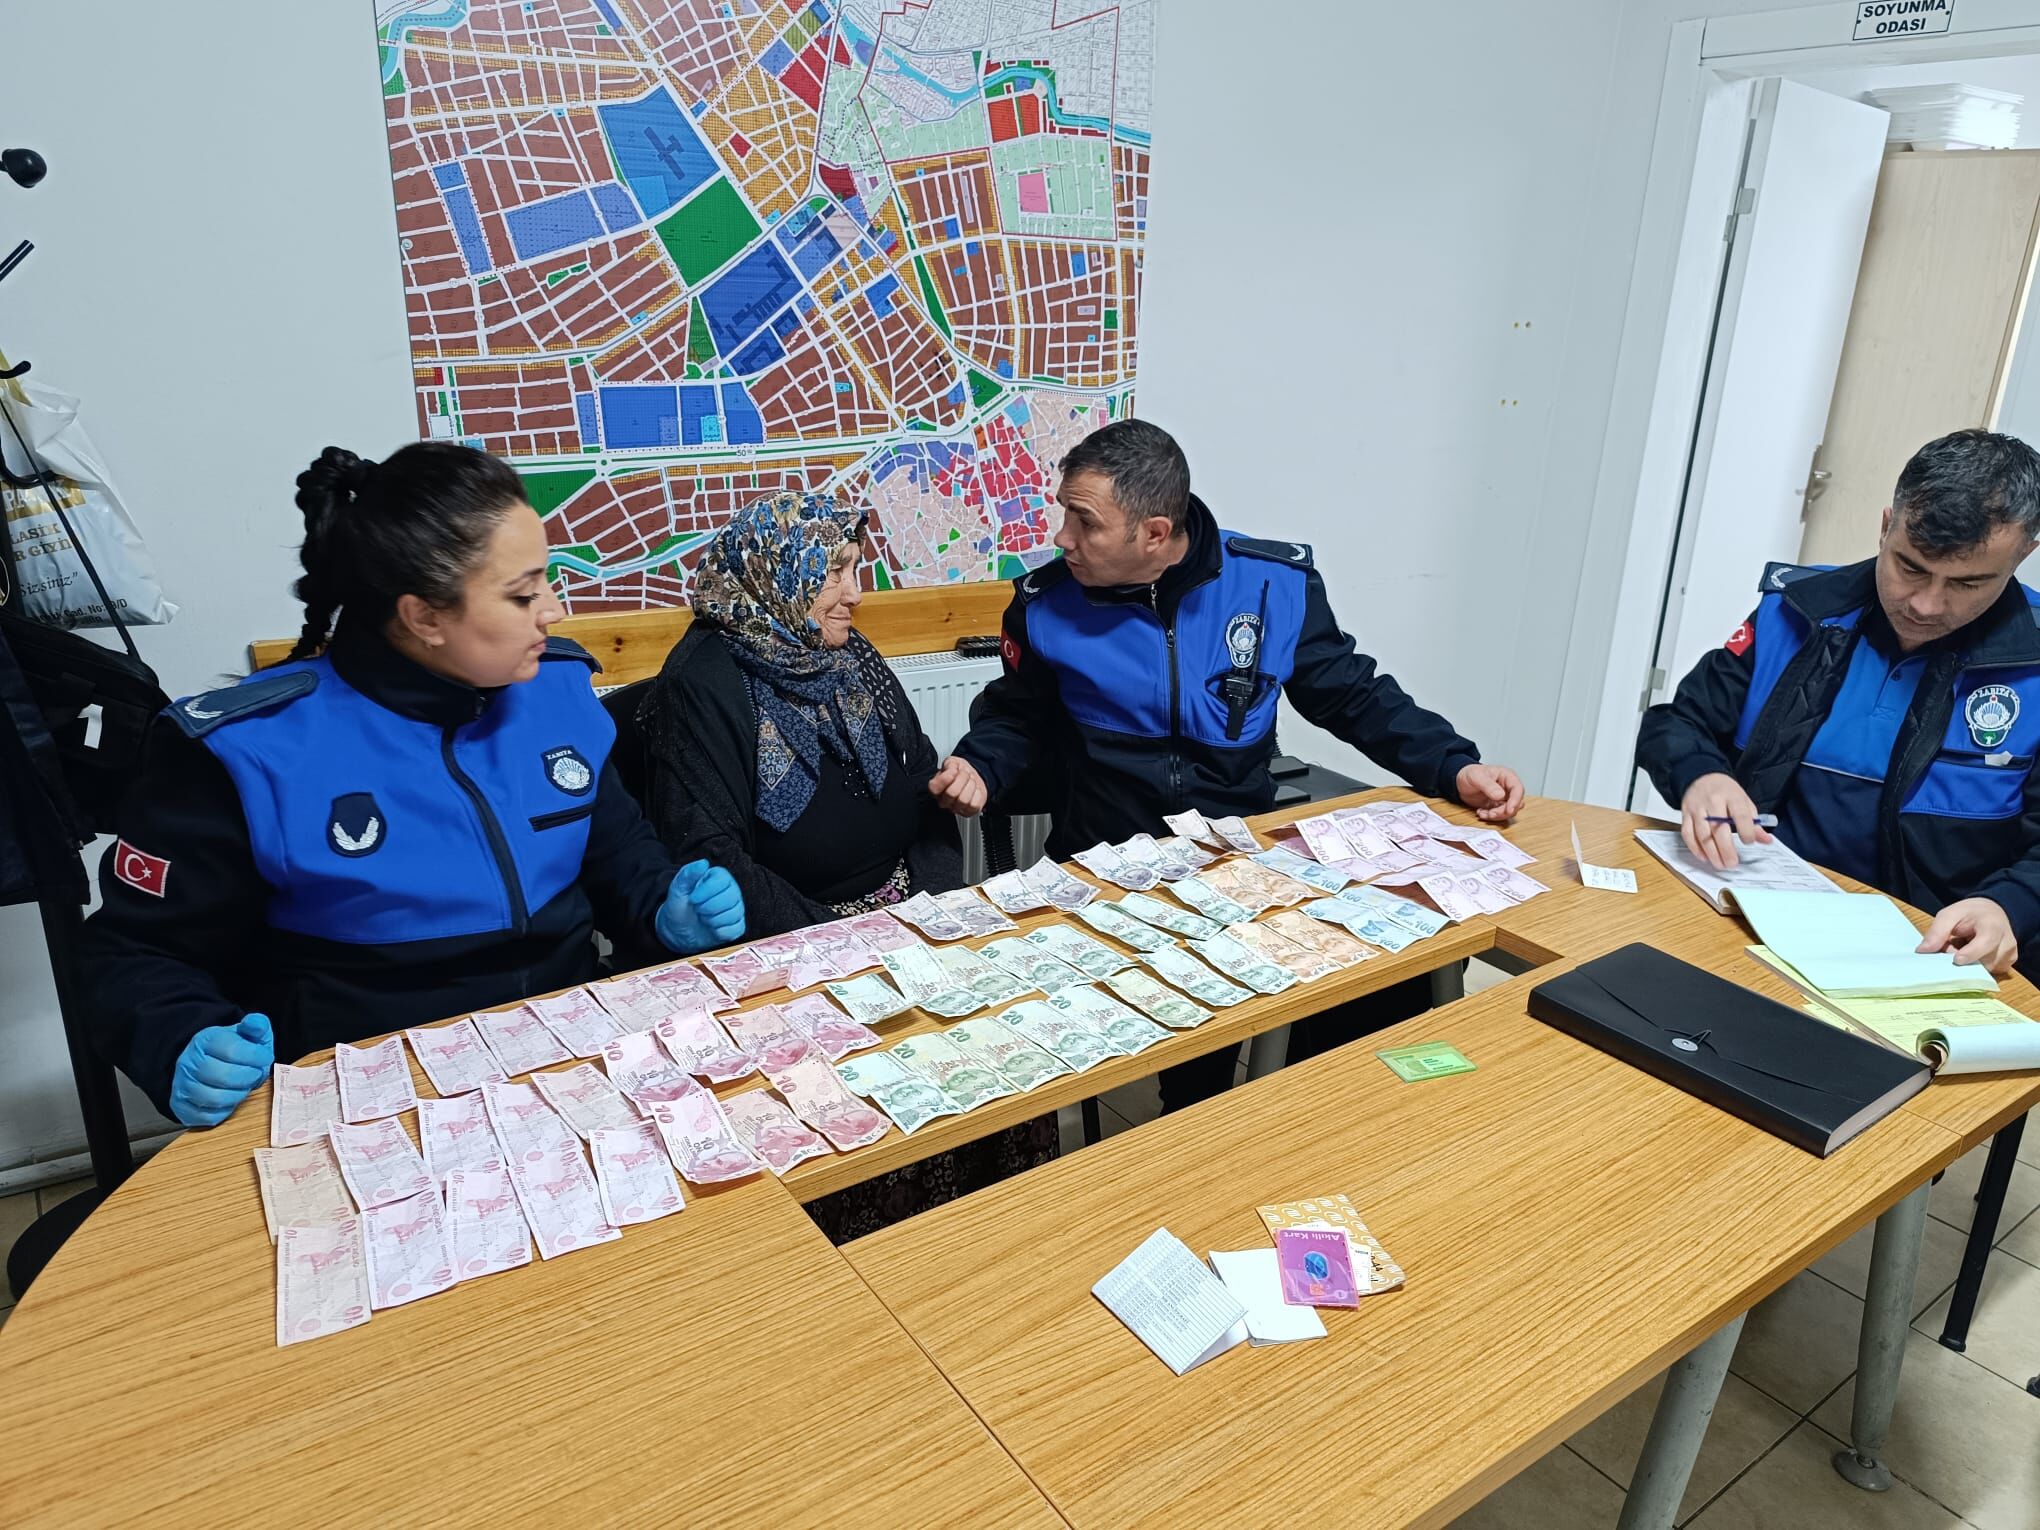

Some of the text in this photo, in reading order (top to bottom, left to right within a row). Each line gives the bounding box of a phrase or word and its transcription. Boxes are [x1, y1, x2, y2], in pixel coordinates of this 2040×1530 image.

[1863, 0, 1946, 18] SOYUNMA
[1876, 18, 1926, 34] ODASI
[1977, 687, 2010, 697] ZABITA
[1313, 845, 1330, 862] 200
[1355, 842, 1373, 857] 200
[1321, 879, 1340, 892] 100
[1342, 892, 1362, 903] 100
[1443, 902, 1463, 919] 200
[1413, 919, 1437, 935] 100
[1029, 932, 1048, 943] 20
[1379, 937, 1401, 951] 100
[979, 947, 1001, 959] 20
[881, 954, 900, 972] 20
[829, 984, 849, 996] 20
[1050, 996, 1072, 1010] 20
[725, 1016, 743, 1028] 10
[1003, 1010, 1024, 1026] 20
[658, 1017, 677, 1038] 10
[949, 1028, 971, 1043] 20
[604, 1041, 624, 1062] 10
[894, 1043, 916, 1059] 20
[838, 1066, 859, 1082] 20
[776, 1075, 798, 1094] 10
[655, 1104, 675, 1124] 10
[700, 1136, 715, 1150] 10
[338, 1219, 357, 1236] 10
[1284, 1231, 1341, 1241] Akıllı Kart
[343, 1305, 364, 1324] 10
